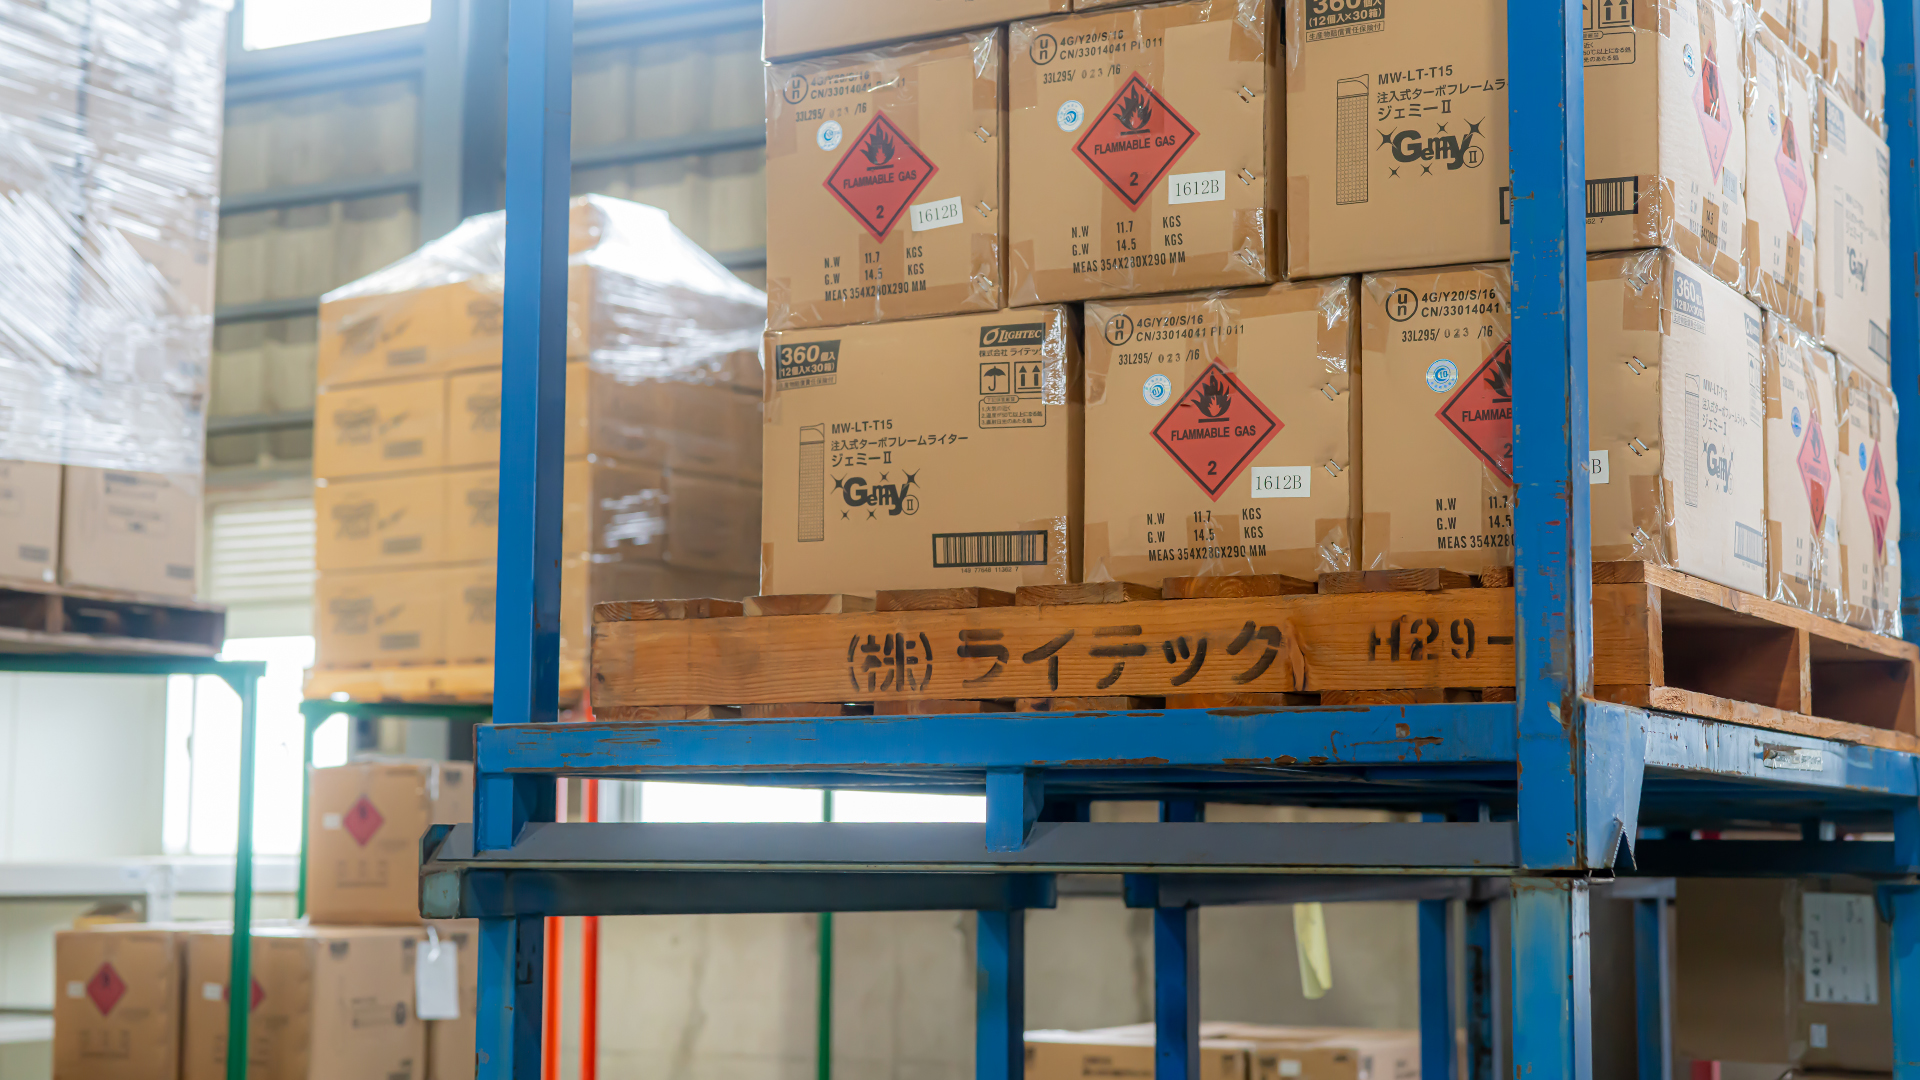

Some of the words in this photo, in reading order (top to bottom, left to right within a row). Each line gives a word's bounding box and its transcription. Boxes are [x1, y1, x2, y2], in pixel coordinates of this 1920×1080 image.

[1060, 41, 1127, 60] CN/33014041
[1378, 64, 1453, 85] MW-LT-T15
[1377, 79, 1508, 103] 注入式ターボフレームラ
[1094, 137, 1150, 155] FLAMMABLE
[1155, 135, 1176, 148] GAS
[843, 172, 895, 190] FLAMMABLE
[898, 169, 917, 182] GAS
[1129, 171, 1139, 186] 2
[1175, 179, 1220, 197] 1612B
[875, 204, 885, 219] 2
[918, 203, 958, 224] 1612B
[1071, 225, 1089, 239] N.W
[1116, 220, 1133, 234] 11.7
[1162, 215, 1182, 229] KGS
[1071, 243, 1089, 256] G.W
[1116, 238, 1137, 252] 14.5
[1164, 233, 1183, 247] KGS
[864, 251, 881, 264] 11.7
[906, 245, 923, 259] KGS
[1072, 260, 1098, 274] MEAS
[1100, 252, 1166, 272] 354X280X290
[1169, 250, 1186, 264] MM
[864, 267, 883, 281] 14.5
[907, 262, 925, 276] KGS
[825, 288, 848, 302] MEAS
[911, 279, 927, 293] MM
[1421, 288, 1496, 303] 4G/Y20/S/16
[1421, 302, 1500, 318] CN/33014041
[1136, 314, 1204, 329] 4G/Y20/S/16
[1136, 327, 1206, 342] CN/33014041
[1401, 328, 1440, 342] 33L295/
[1477, 325, 1493, 339] /16
[1118, 352, 1153, 366] 33L295/
[1186, 348, 1200, 362] /16
[831, 418, 893, 434] MW-LT-T15
[1171, 426, 1230, 441] FLAMMABLE
[1234, 425, 1256, 437] GAS
[830, 433, 969, 452] 注入式ターボフレームライター
[1503, 442, 1512, 458] 2
[1207, 460, 1217, 475] 2
[1255, 474, 1302, 491] 1612B
[1435, 497, 1456, 511] N.W
[1488, 495, 1508, 509] 11.7
[1146, 512, 1165, 526] N.W
[1193, 510, 1211, 523] 11.7
[1242, 507, 1262, 521] KGS
[1436, 516, 1456, 530] G.W
[1488, 514, 1512, 528] 14.5
[1147, 531, 1165, 543] G.W
[1193, 528, 1215, 541] 14.5
[1244, 526, 1264, 539] KGS
[1437, 535, 1467, 550] MEAS
[1148, 548, 1175, 561] MEAS
[1177, 544, 1246, 561] 354X280X290
[1249, 544, 1266, 557] MM
